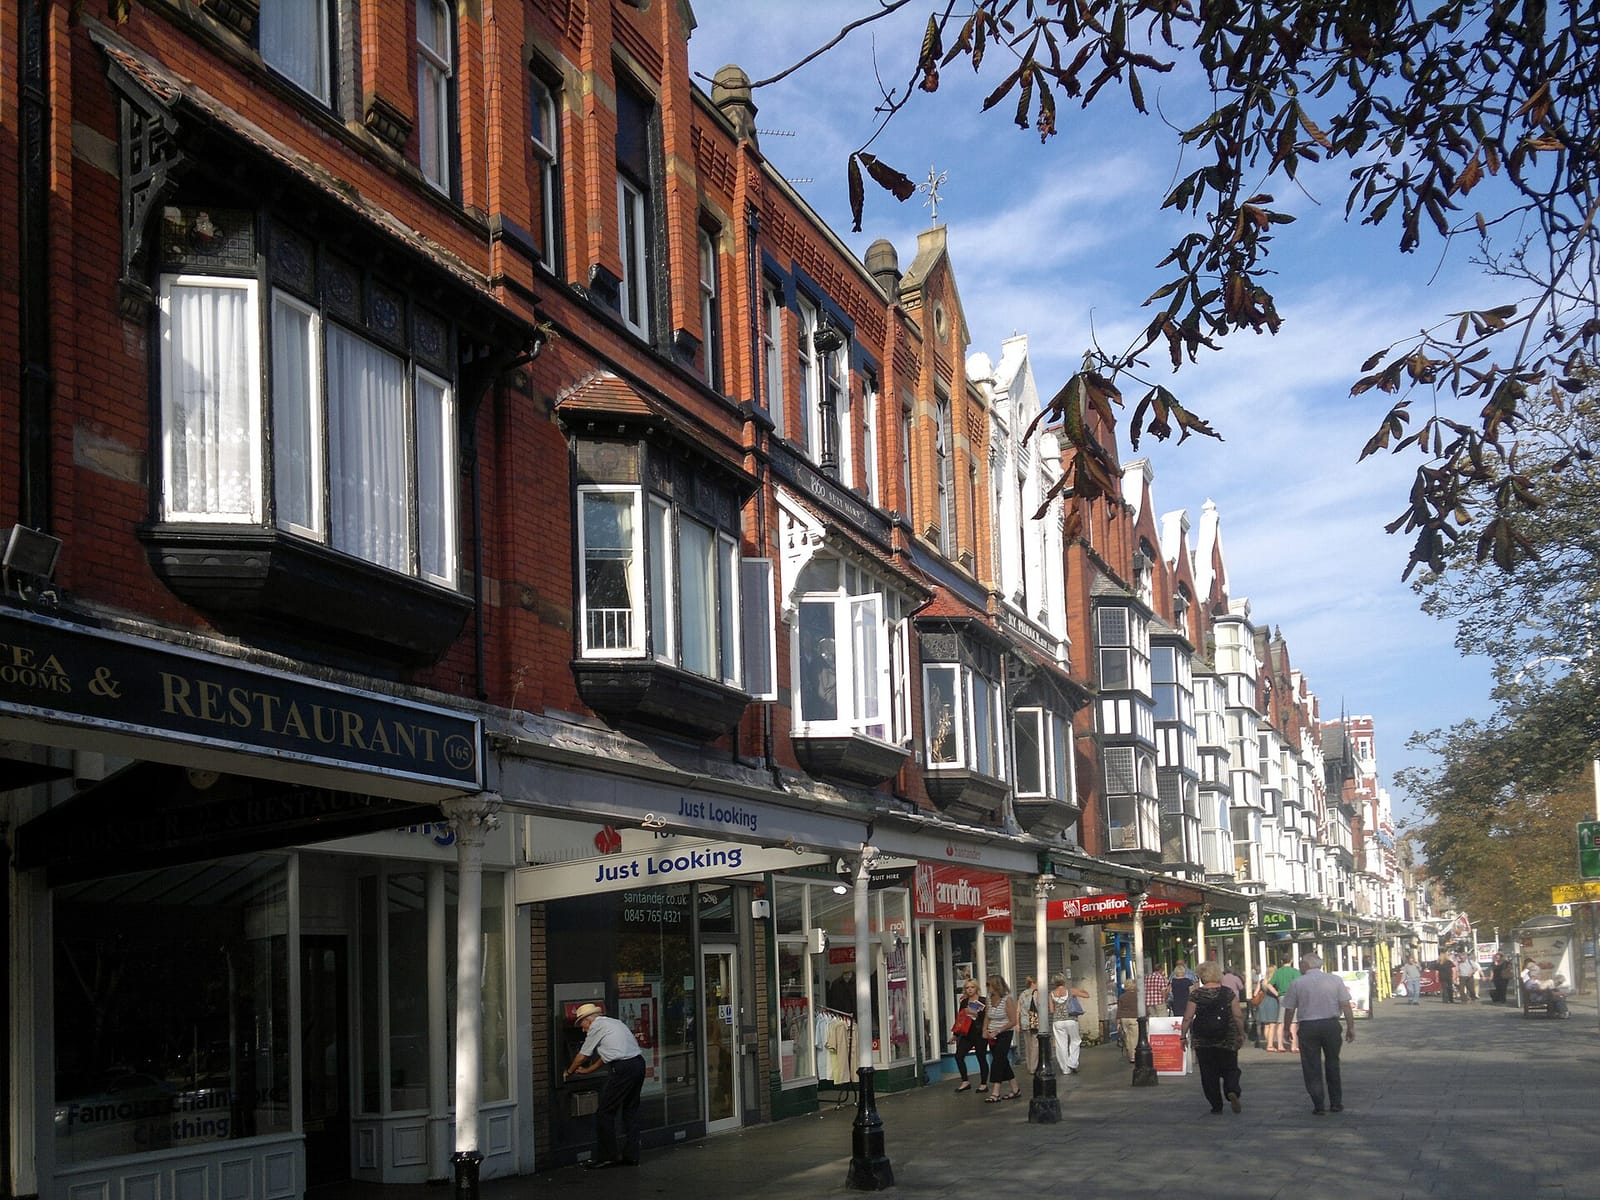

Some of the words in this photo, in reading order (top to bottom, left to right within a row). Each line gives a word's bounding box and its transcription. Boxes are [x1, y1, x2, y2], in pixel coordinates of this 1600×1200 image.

[0, 665, 72, 694] OOMS
[88, 666, 121, 699] &
[159, 671, 440, 762] RESTAURANT
[449, 744, 470, 762] 165
[678, 797, 706, 819] Just
[709, 802, 758, 832] Looking
[595, 860, 639, 883] Just
[647, 847, 742, 876] Looking
[872, 874, 885, 882] SUIT
[624, 891, 687, 906] santander.co.uk
[936, 878, 981, 910] amplifon
[624, 909, 645, 922] 0845
[647, 909, 662, 922] 765
[663, 910, 681, 923] 4321
[1264, 912, 1287, 923] ACK
